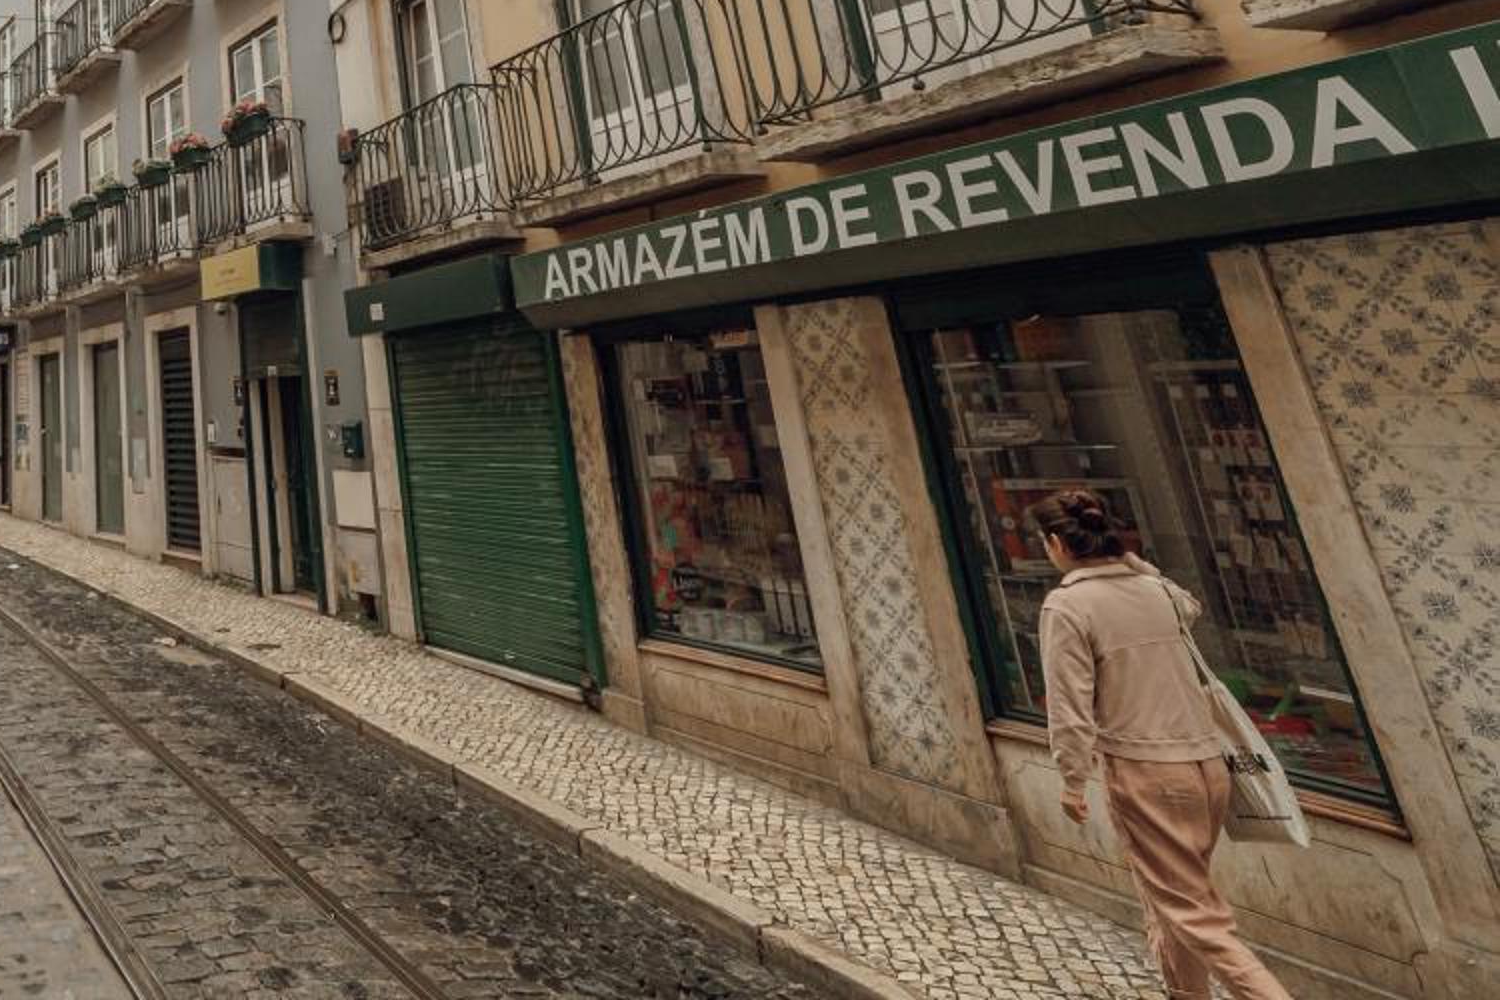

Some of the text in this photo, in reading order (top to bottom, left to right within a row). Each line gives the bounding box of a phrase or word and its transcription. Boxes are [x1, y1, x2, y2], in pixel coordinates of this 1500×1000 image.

[544, 207, 771, 300] ARMAZÉM
[786, 184, 877, 257] DE
[892, 75, 1418, 238] REVENDA
